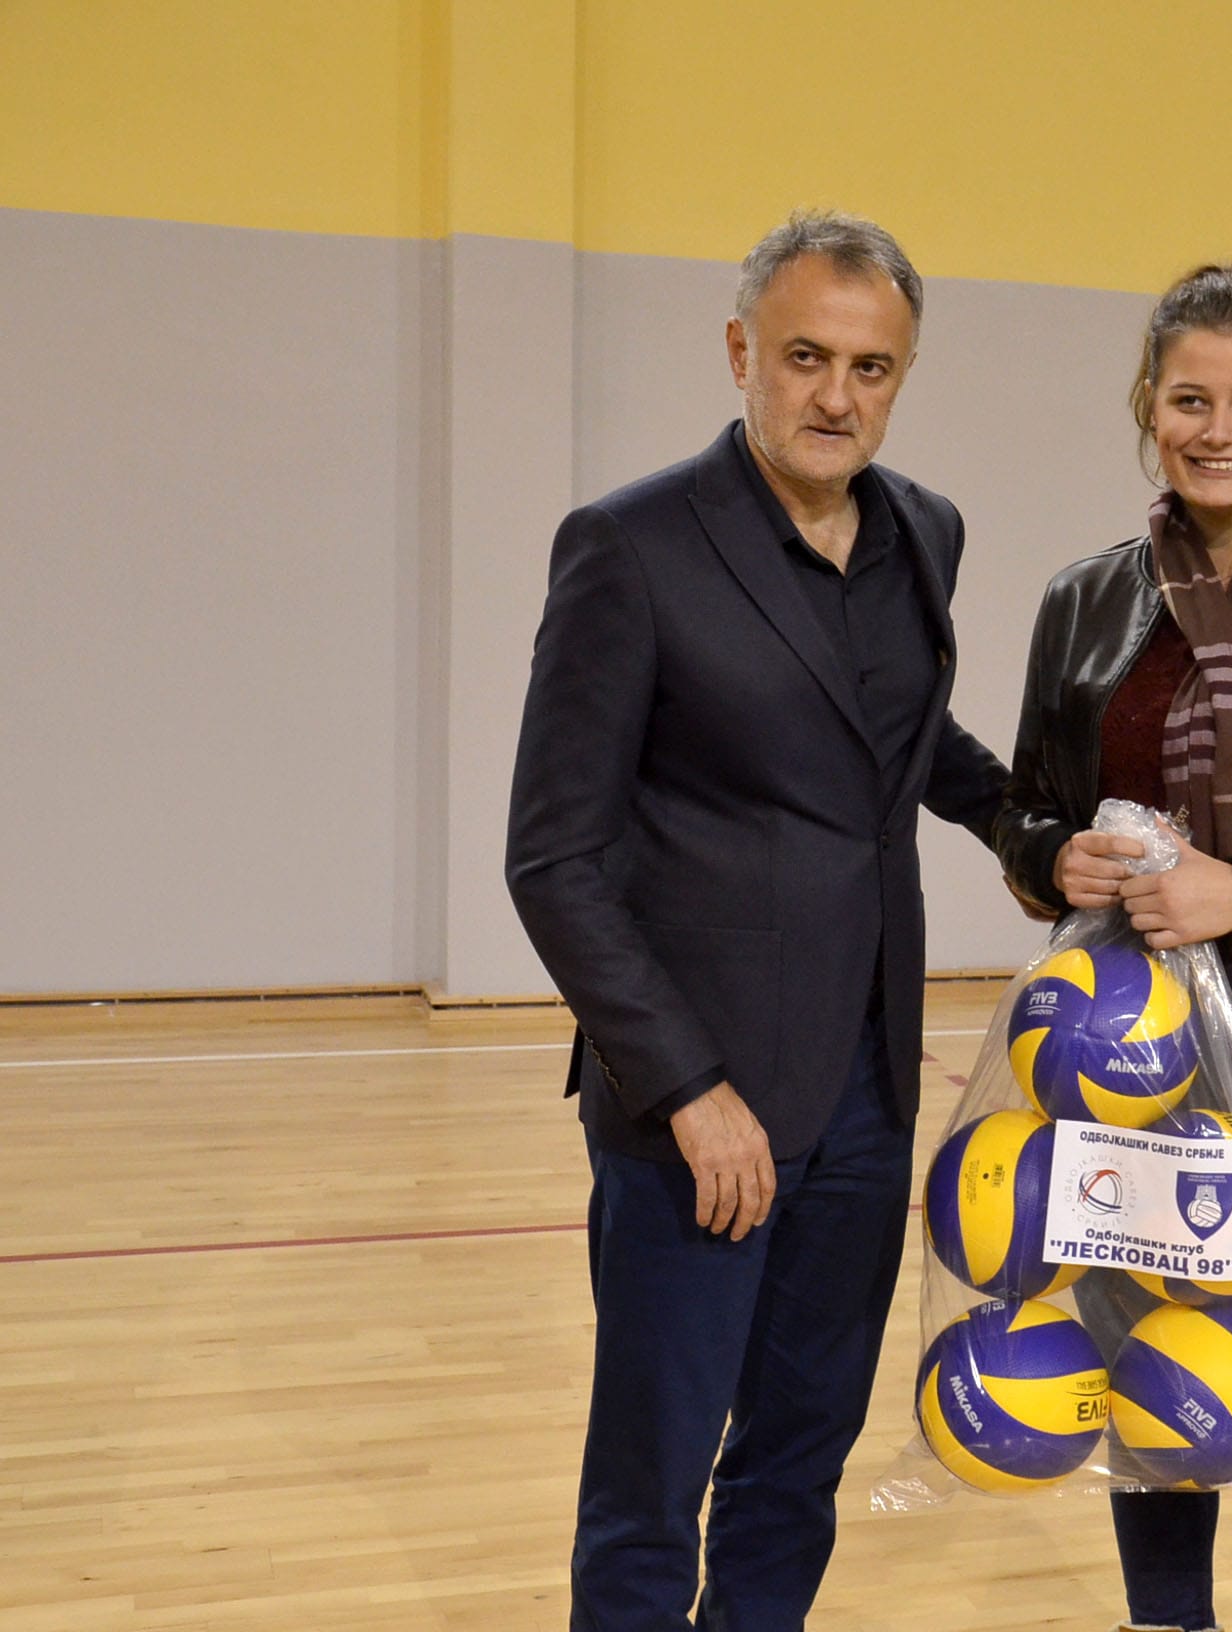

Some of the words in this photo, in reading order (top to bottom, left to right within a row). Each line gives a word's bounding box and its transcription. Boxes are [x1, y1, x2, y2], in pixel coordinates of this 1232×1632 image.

[1029, 991, 1058, 1005] FIVB
[1079, 1130, 1149, 1151] ОДБОЈКАШКИ
[1151, 1142, 1183, 1157] САВЕЗ
[1185, 1147, 1225, 1160] СРБИЈЕ
[1085, 1228, 1167, 1250] Одбојкашки
[1171, 1243, 1205, 1256] клуб
[1183, 1398, 1217, 1430] FIVB
